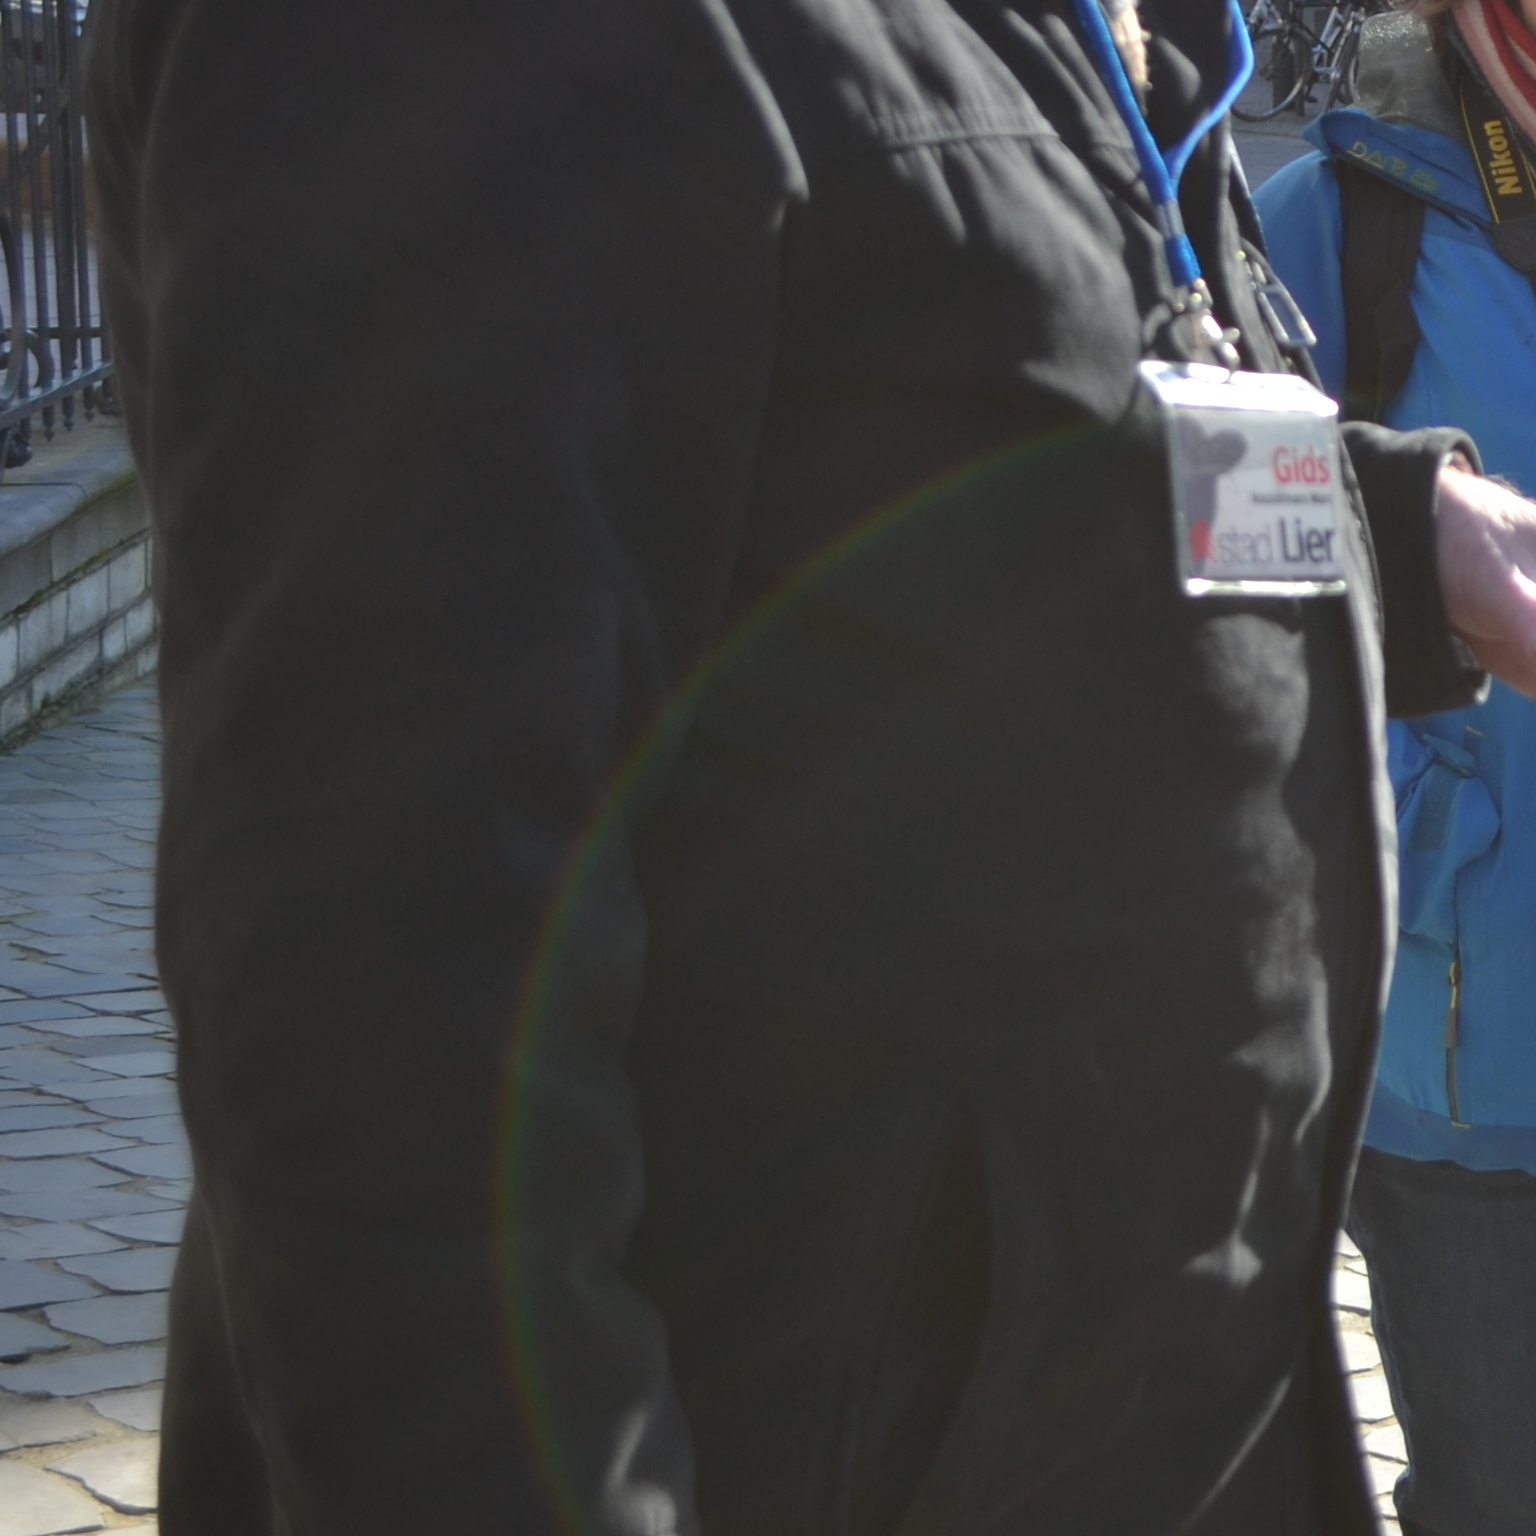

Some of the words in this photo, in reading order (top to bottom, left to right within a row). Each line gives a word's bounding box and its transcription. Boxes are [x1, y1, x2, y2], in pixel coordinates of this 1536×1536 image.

[1483, 119, 1523, 196] Nikon
[1272, 444, 1332, 484] Gids
[1278, 516, 1336, 564] Lier
